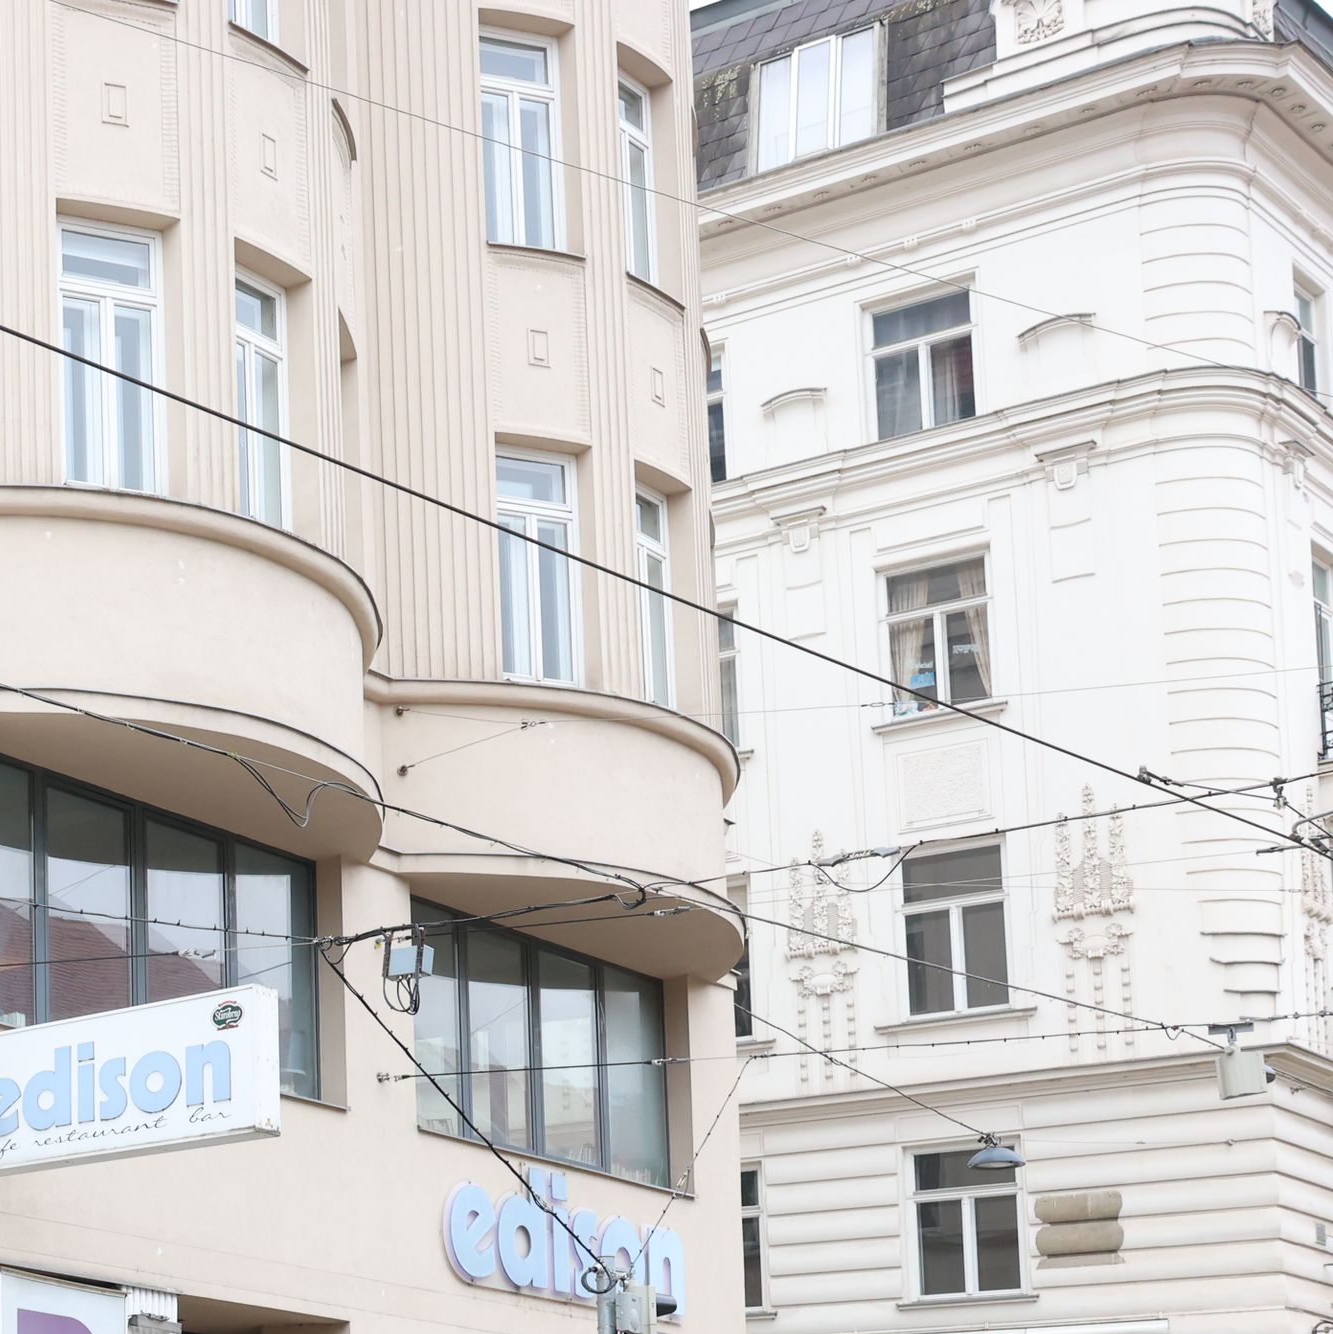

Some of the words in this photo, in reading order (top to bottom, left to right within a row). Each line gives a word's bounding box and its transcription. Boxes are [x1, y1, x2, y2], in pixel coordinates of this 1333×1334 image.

[33, 1115, 168, 1147] restaurant
[188, 1106, 231, 1125] bar
[443, 1166, 686, 1318] edison
